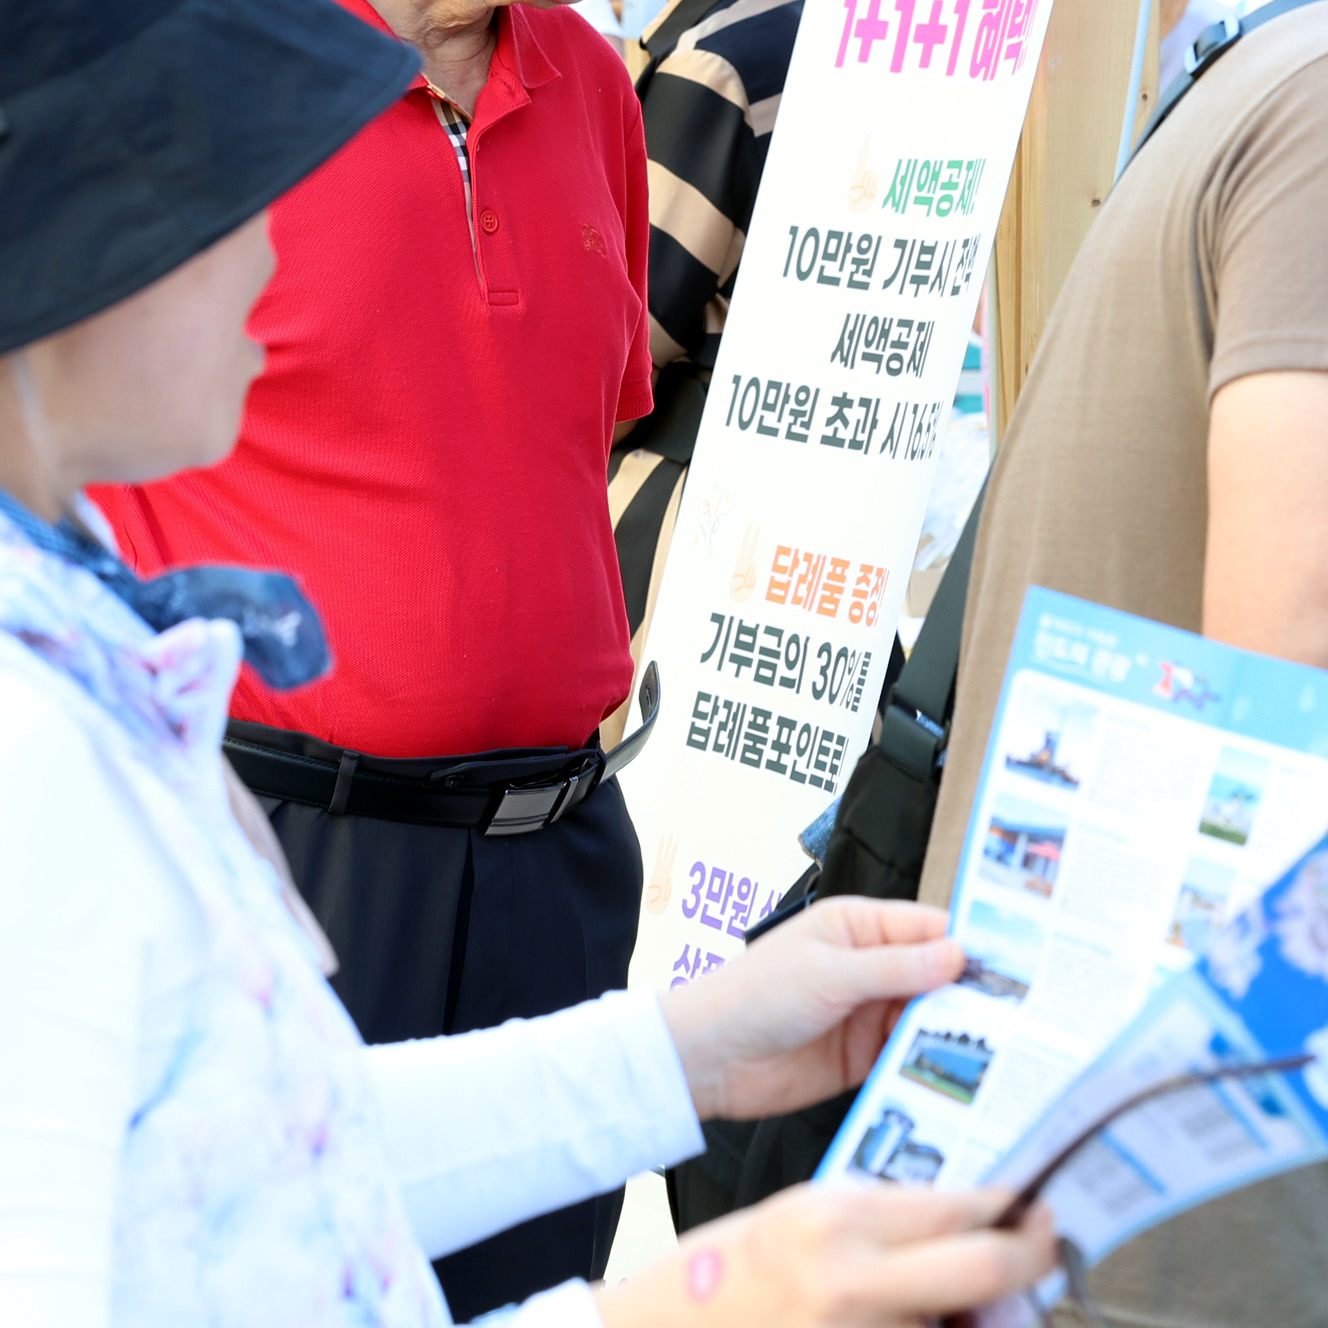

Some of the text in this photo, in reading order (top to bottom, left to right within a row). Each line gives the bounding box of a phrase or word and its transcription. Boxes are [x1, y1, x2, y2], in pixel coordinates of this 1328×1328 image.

[782, 225, 882, 291] 10만원
[830, 313, 935, 379] 세액공제
[725, 374, 820, 443] 10만원
[820, 391, 881, 455] 초과
[764, 544, 850, 619] 답례품
[700, 611, 811, 695] 기부금의
[682, 860, 759, 942] 3만원
